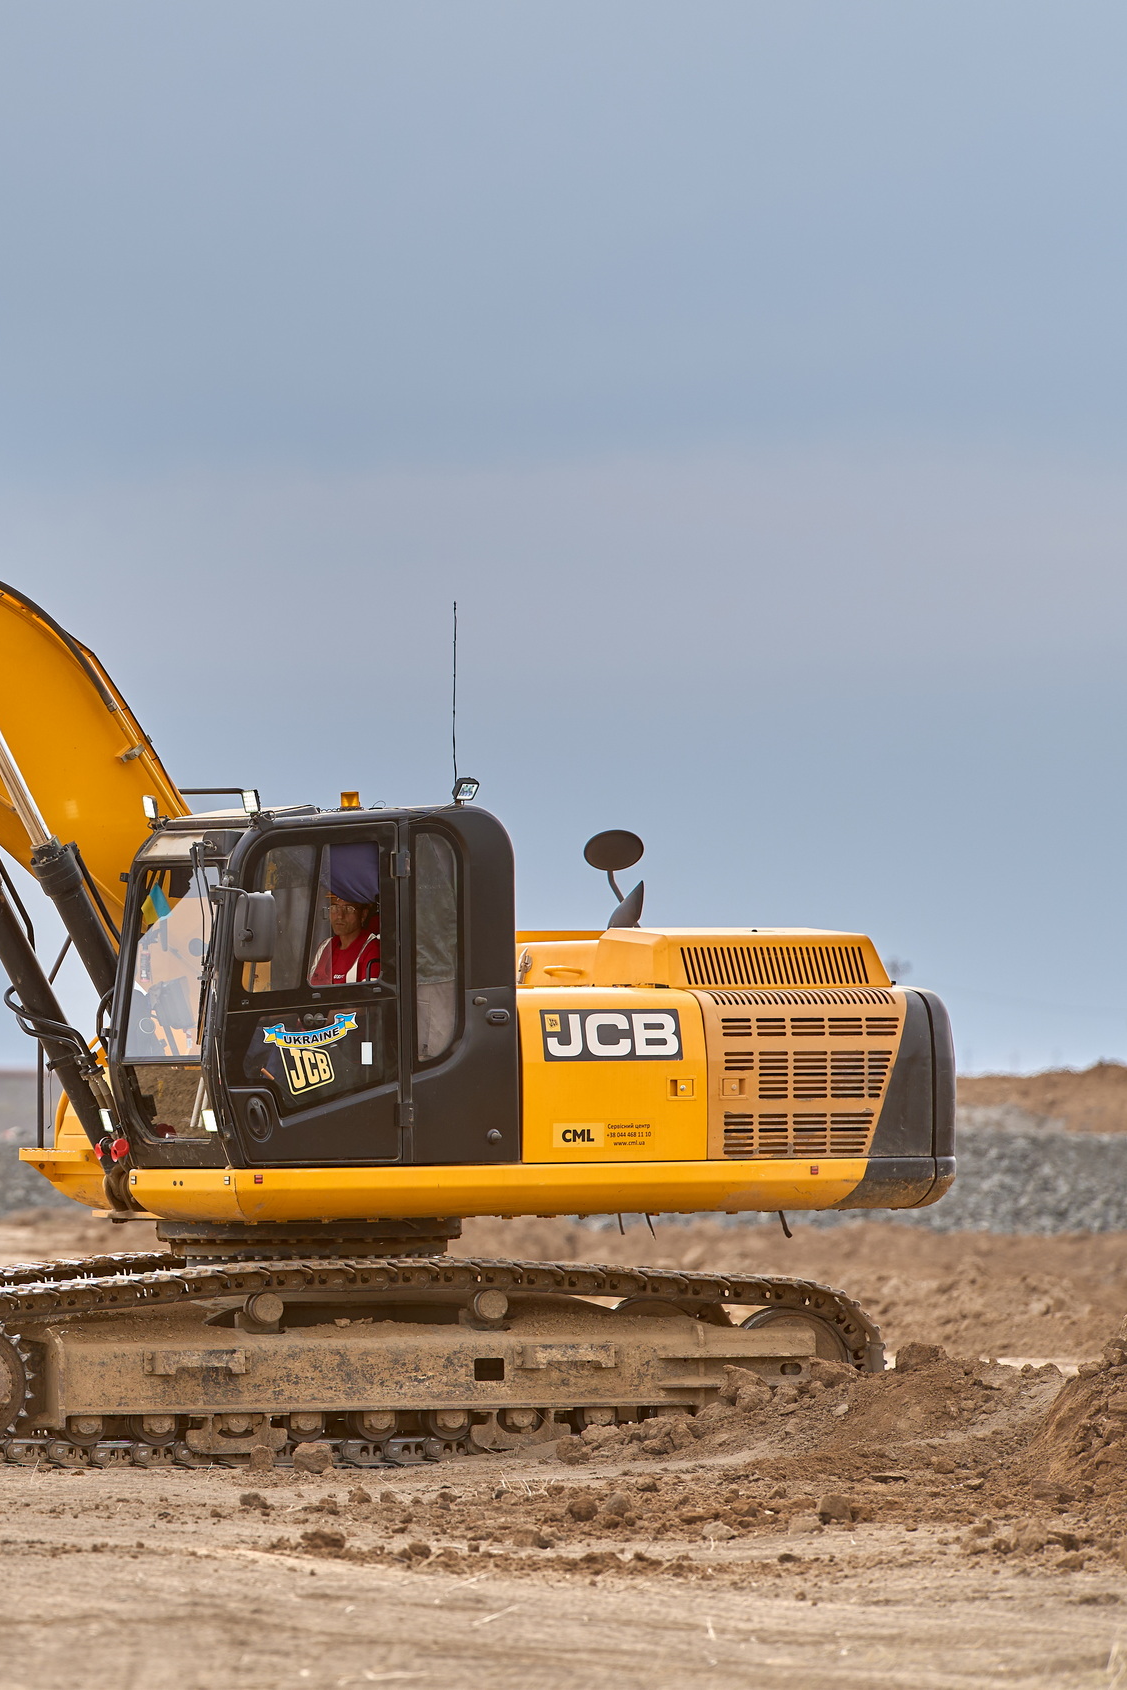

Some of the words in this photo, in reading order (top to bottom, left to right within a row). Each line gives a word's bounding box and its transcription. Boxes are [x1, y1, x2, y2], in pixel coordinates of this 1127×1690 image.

[283, 1027, 340, 1045] UKRAINE
[546, 1013, 679, 1057] JCB
[289, 1048, 331, 1089] JCB
[561, 1129, 595, 1142] CML
